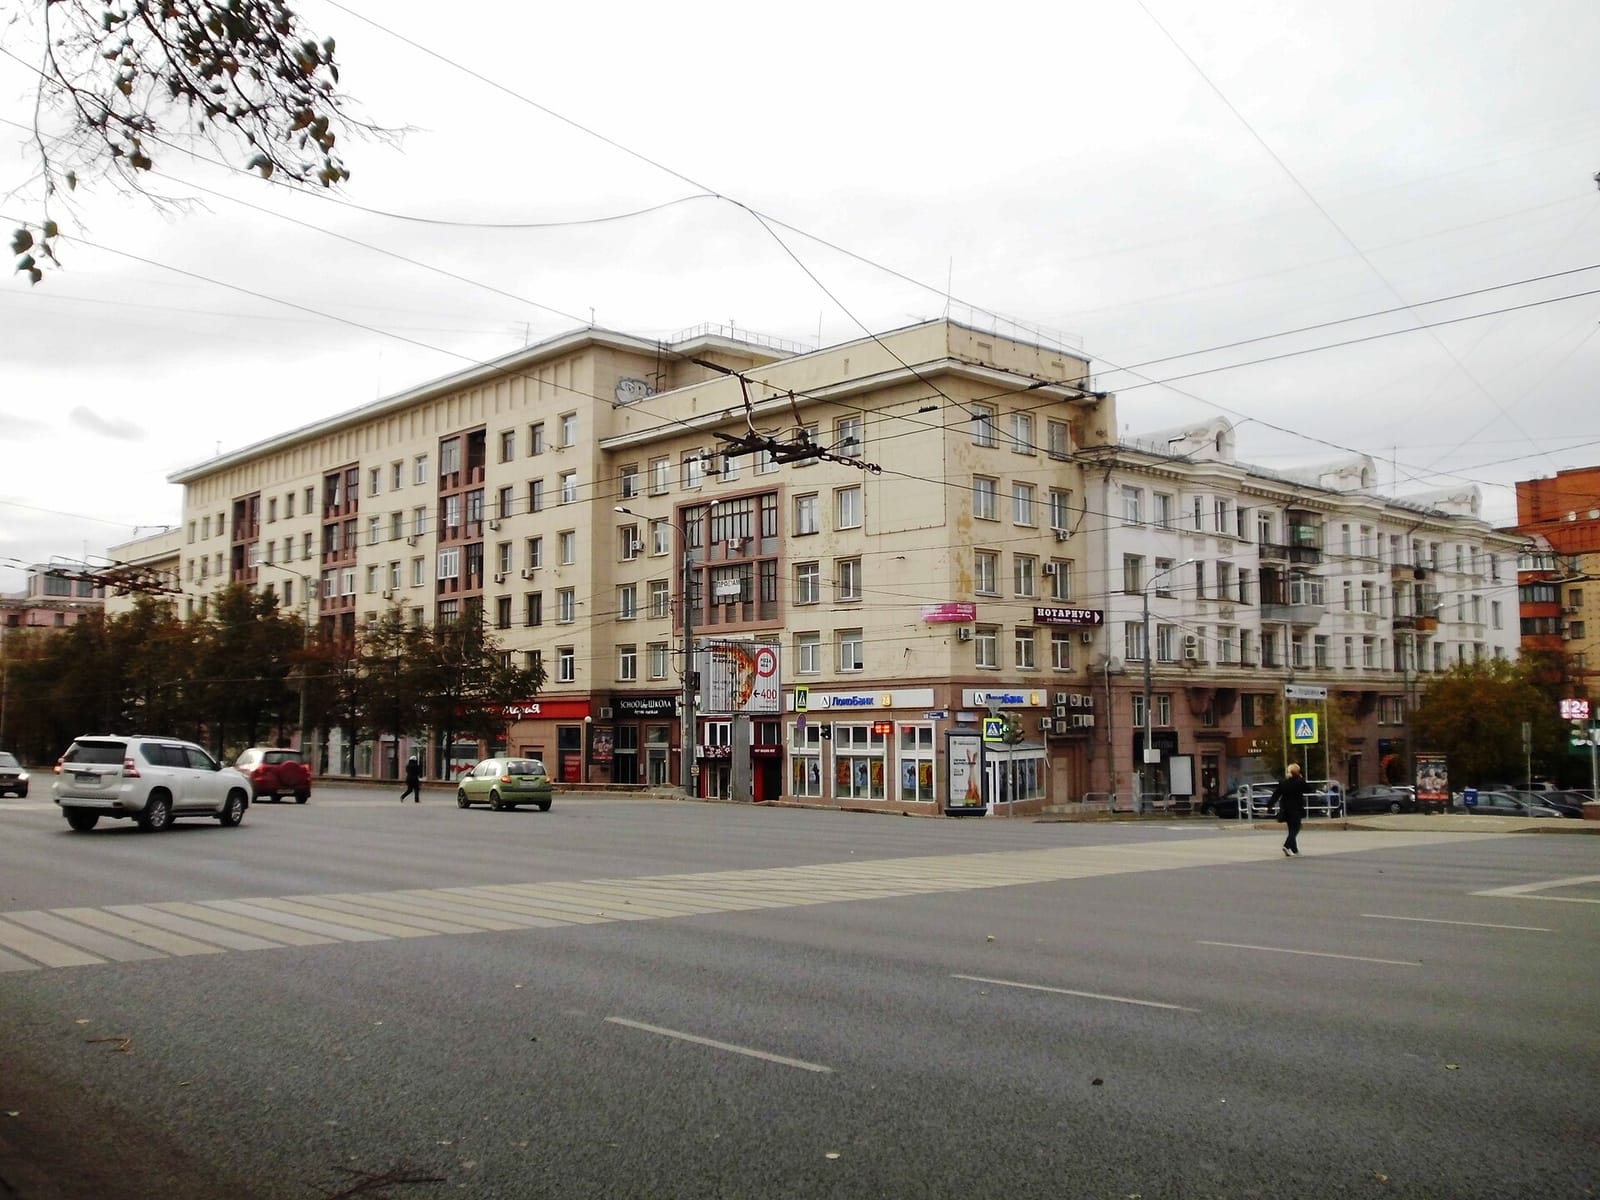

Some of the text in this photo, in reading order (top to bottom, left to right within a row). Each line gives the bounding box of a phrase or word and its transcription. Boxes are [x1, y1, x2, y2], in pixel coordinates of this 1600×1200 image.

[1037, 608, 1091, 619] НОТАРИУС
[760, 688, 777, 700] 400
[832, 696, 874, 706] ЛокоБанк
